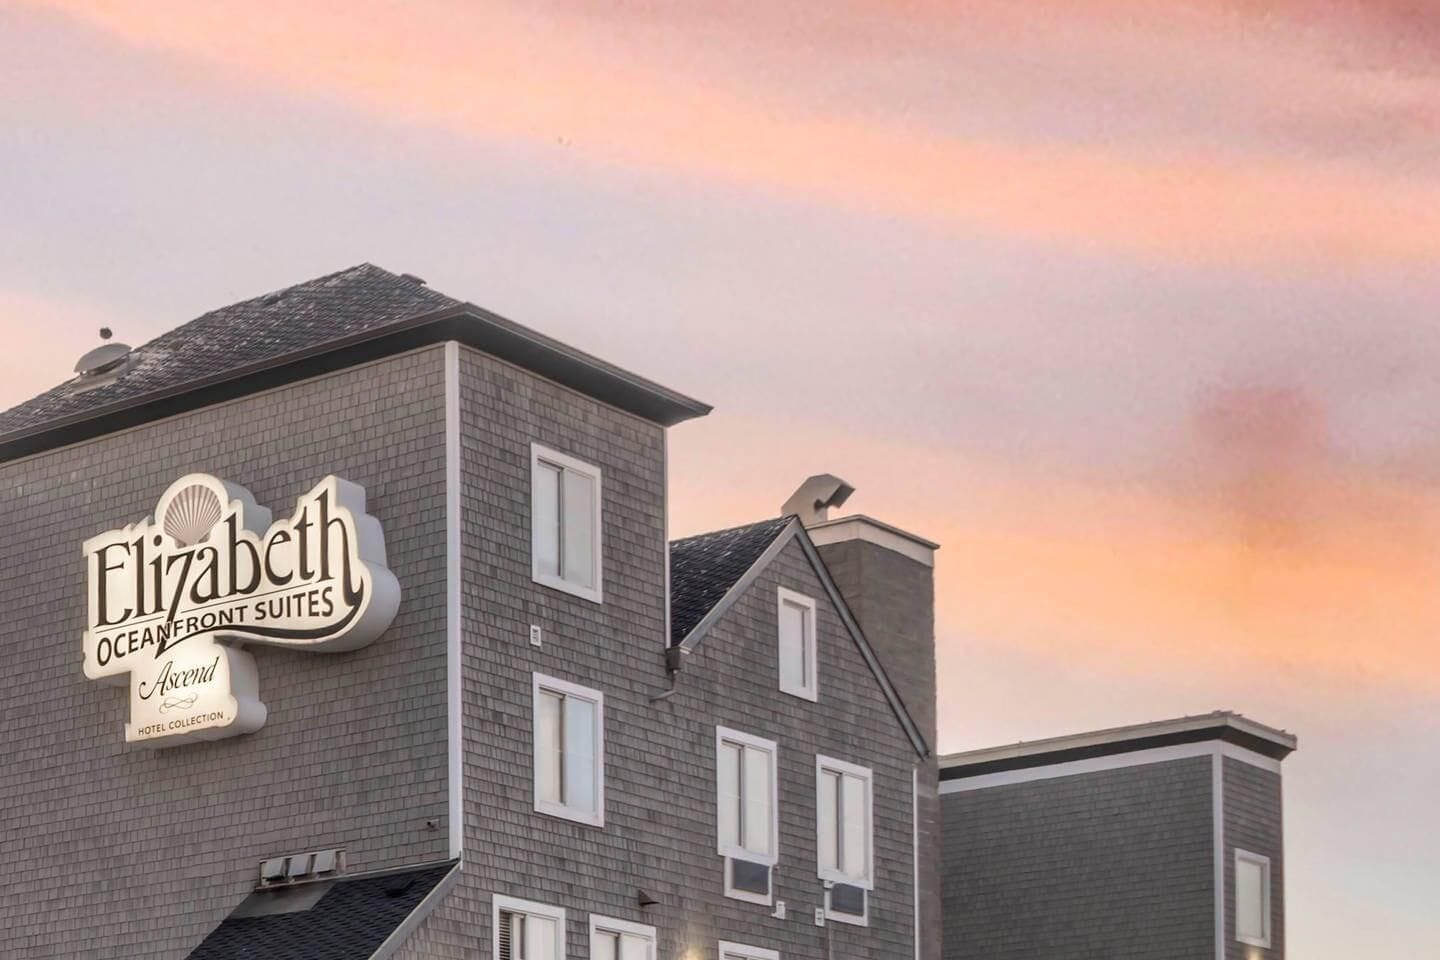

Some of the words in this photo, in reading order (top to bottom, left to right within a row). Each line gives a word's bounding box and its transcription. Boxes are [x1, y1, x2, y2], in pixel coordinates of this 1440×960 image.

[93, 487, 364, 642] Elizabeth
[97, 606, 248, 667] OCEANFRONT
[255, 586, 334, 622] SUITES
[139, 656, 220, 700] Ascend
[137, 722, 166, 737] HOTEL
[168, 711, 224, 730] COLLECTION
